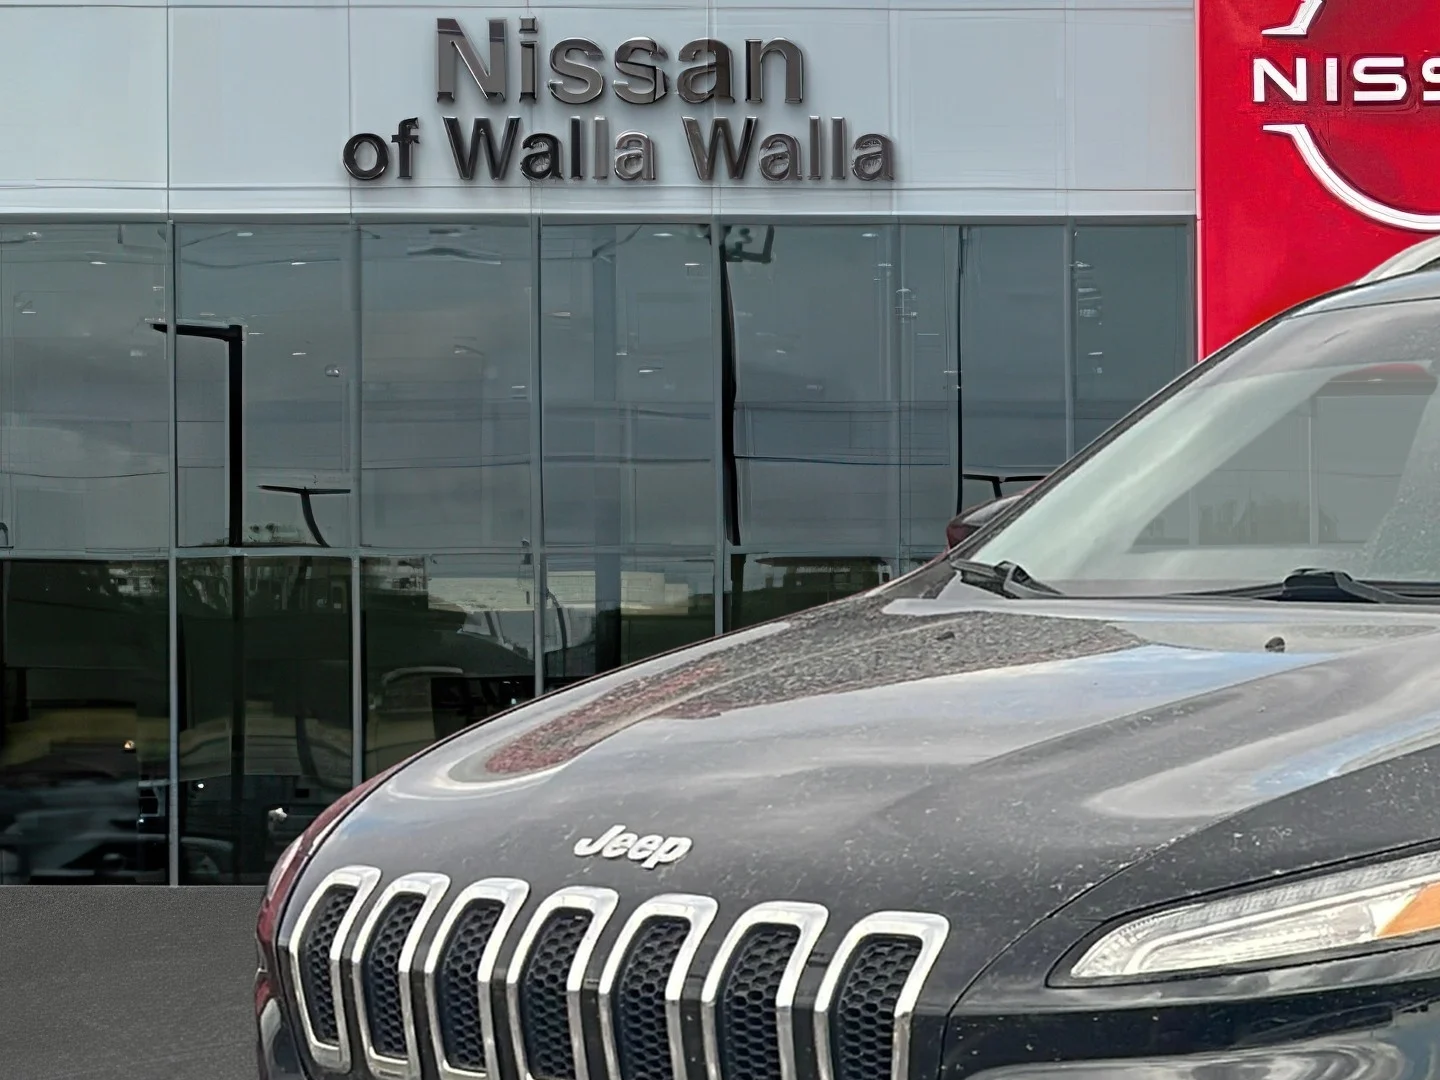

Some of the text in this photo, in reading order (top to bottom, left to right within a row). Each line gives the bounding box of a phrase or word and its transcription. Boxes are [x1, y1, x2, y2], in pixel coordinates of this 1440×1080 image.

[436, 16, 804, 104] Nissan
[342, 115, 895, 181] of Walla Walla
[573, 824, 693, 870] Jeep
